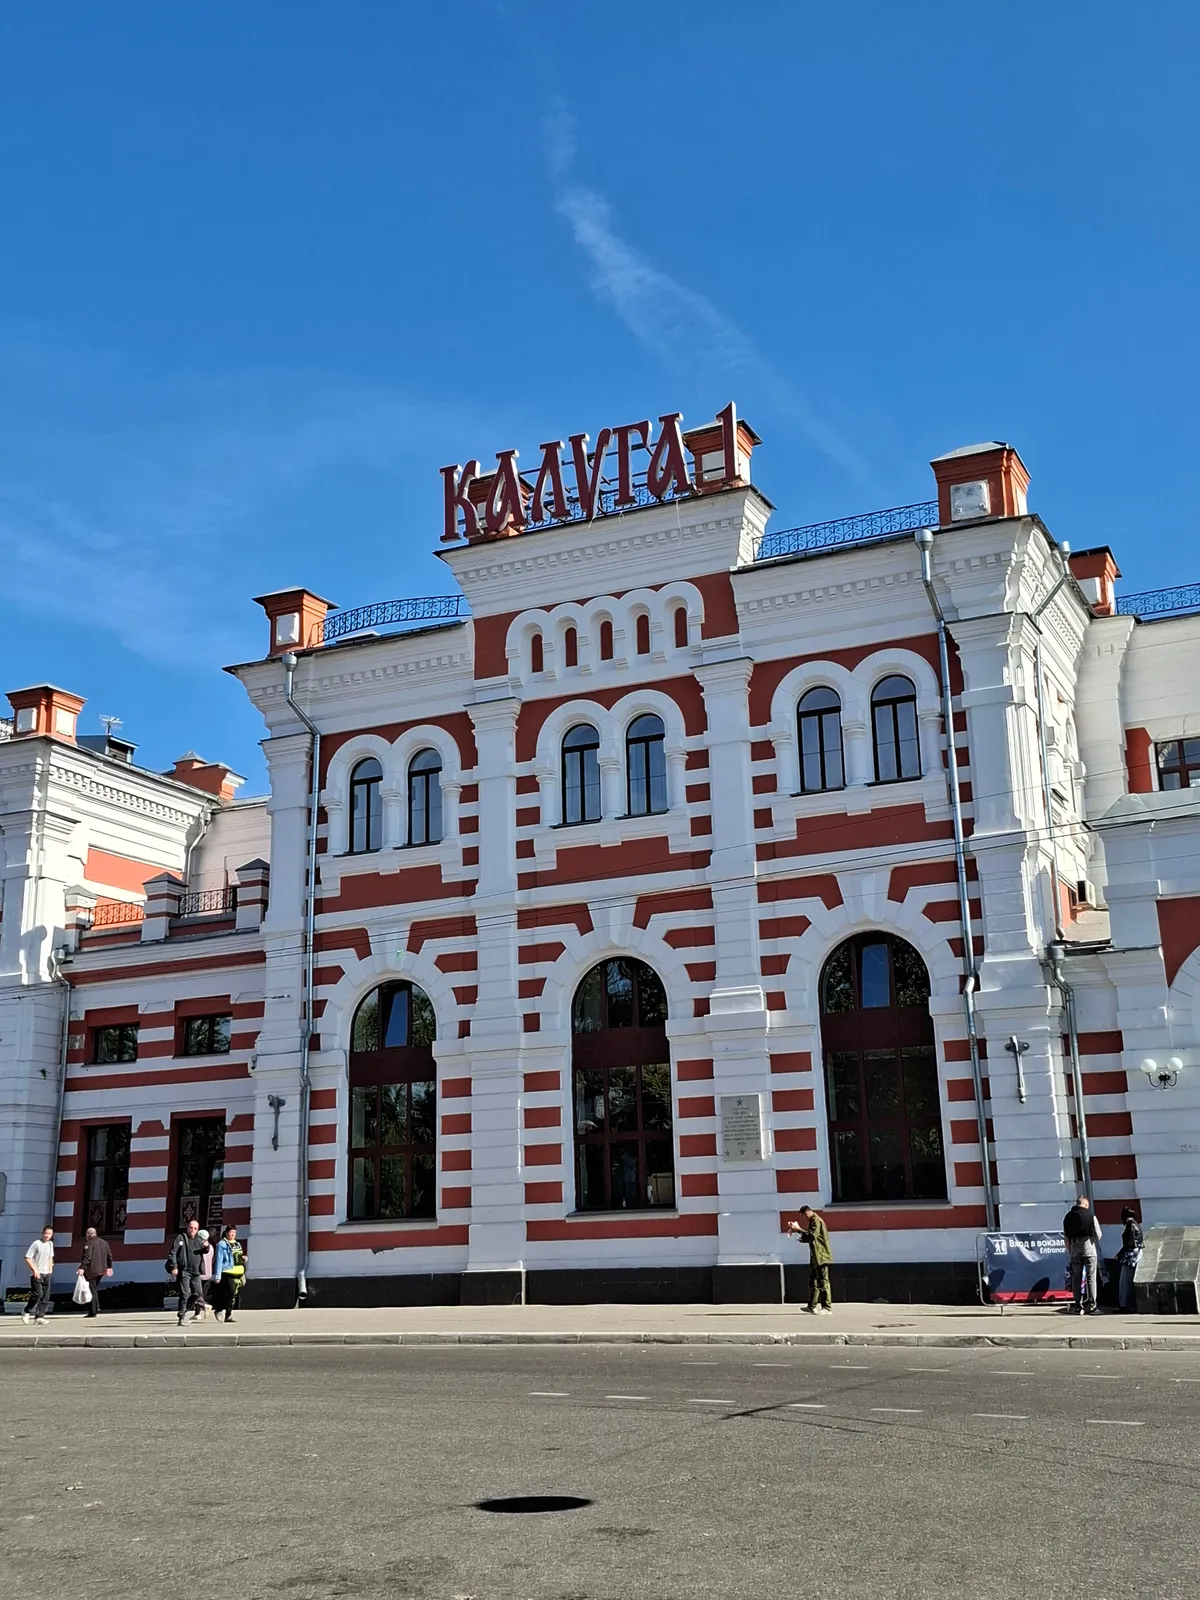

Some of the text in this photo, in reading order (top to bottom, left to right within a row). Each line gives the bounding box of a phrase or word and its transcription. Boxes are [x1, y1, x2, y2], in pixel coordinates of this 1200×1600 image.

[439, 400, 739, 543] КАЛУГА 1
[1009, 1239, 1030, 1248] Вход
